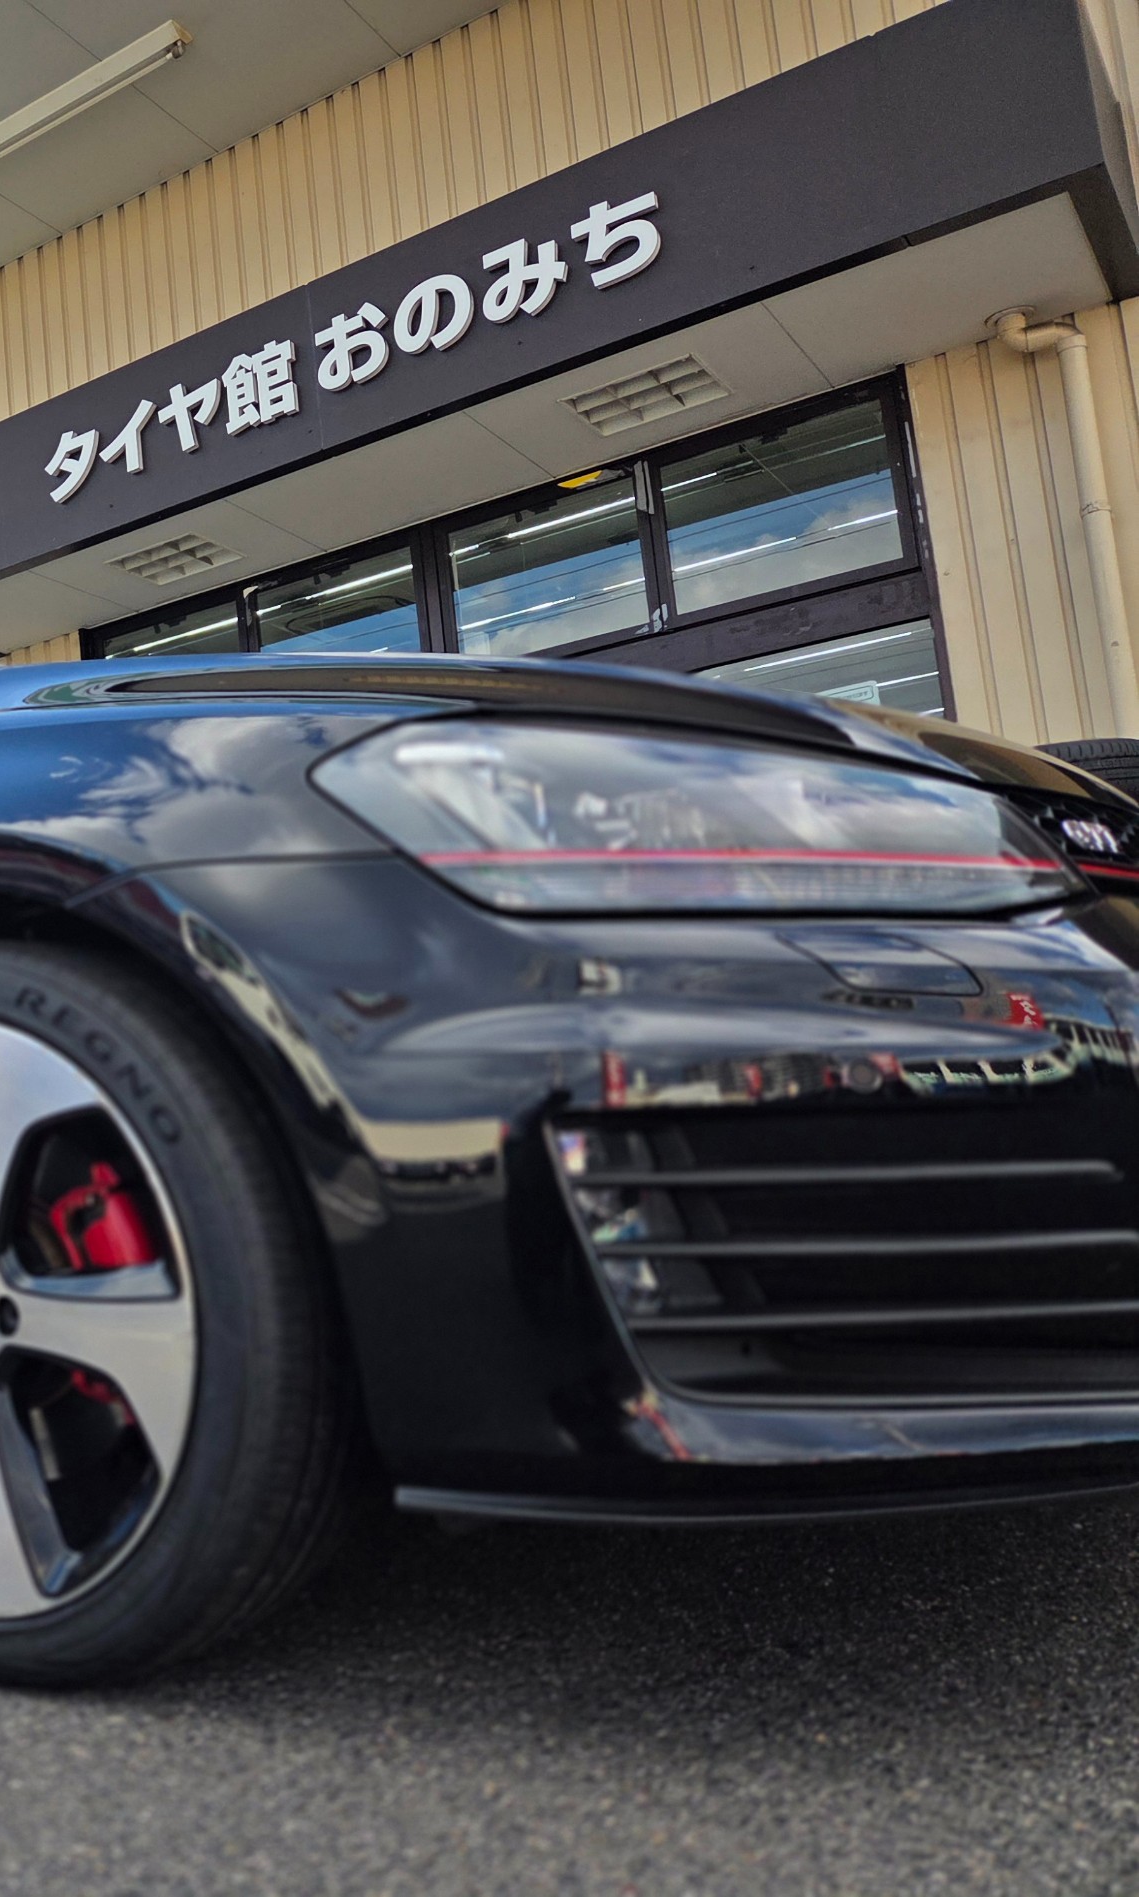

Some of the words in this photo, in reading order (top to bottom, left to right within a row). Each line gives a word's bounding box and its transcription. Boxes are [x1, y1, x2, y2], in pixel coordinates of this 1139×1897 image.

[44, 339, 300, 504] タイヤ館
[314, 190, 662, 392] おのみち
[15, 985, 183, 1145] REGNO
